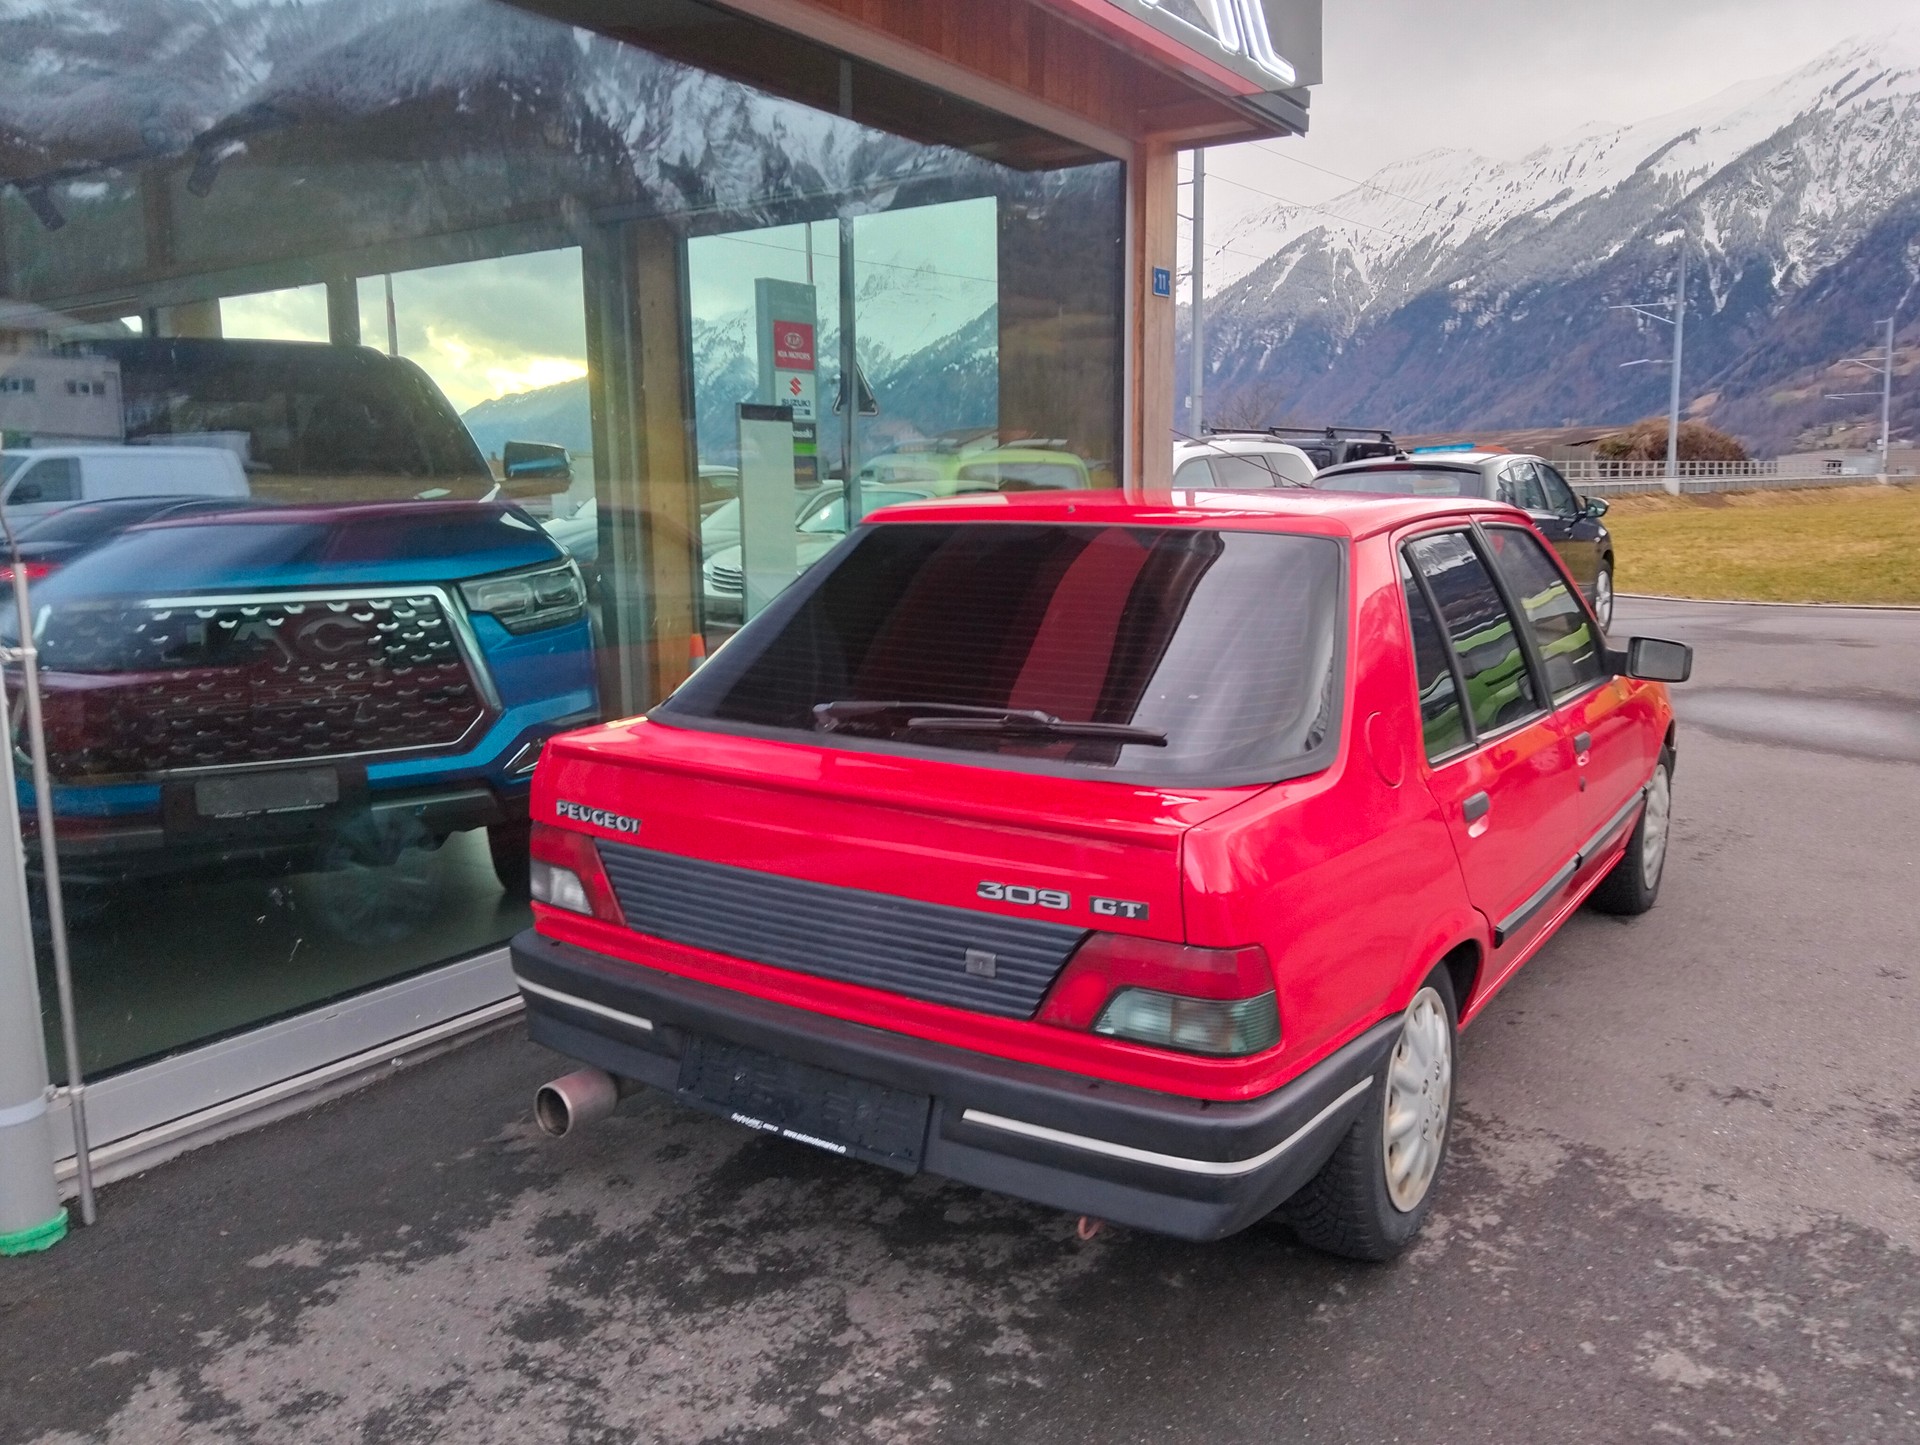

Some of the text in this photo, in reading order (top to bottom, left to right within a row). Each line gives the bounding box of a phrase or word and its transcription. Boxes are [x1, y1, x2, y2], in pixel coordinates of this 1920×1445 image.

[1158, 273, 1166, 291] 11
[781, 398, 811, 407] SUZUKI
[556, 800, 641, 834] PEUGEOT
[976, 880, 1142, 918] 309 GT
